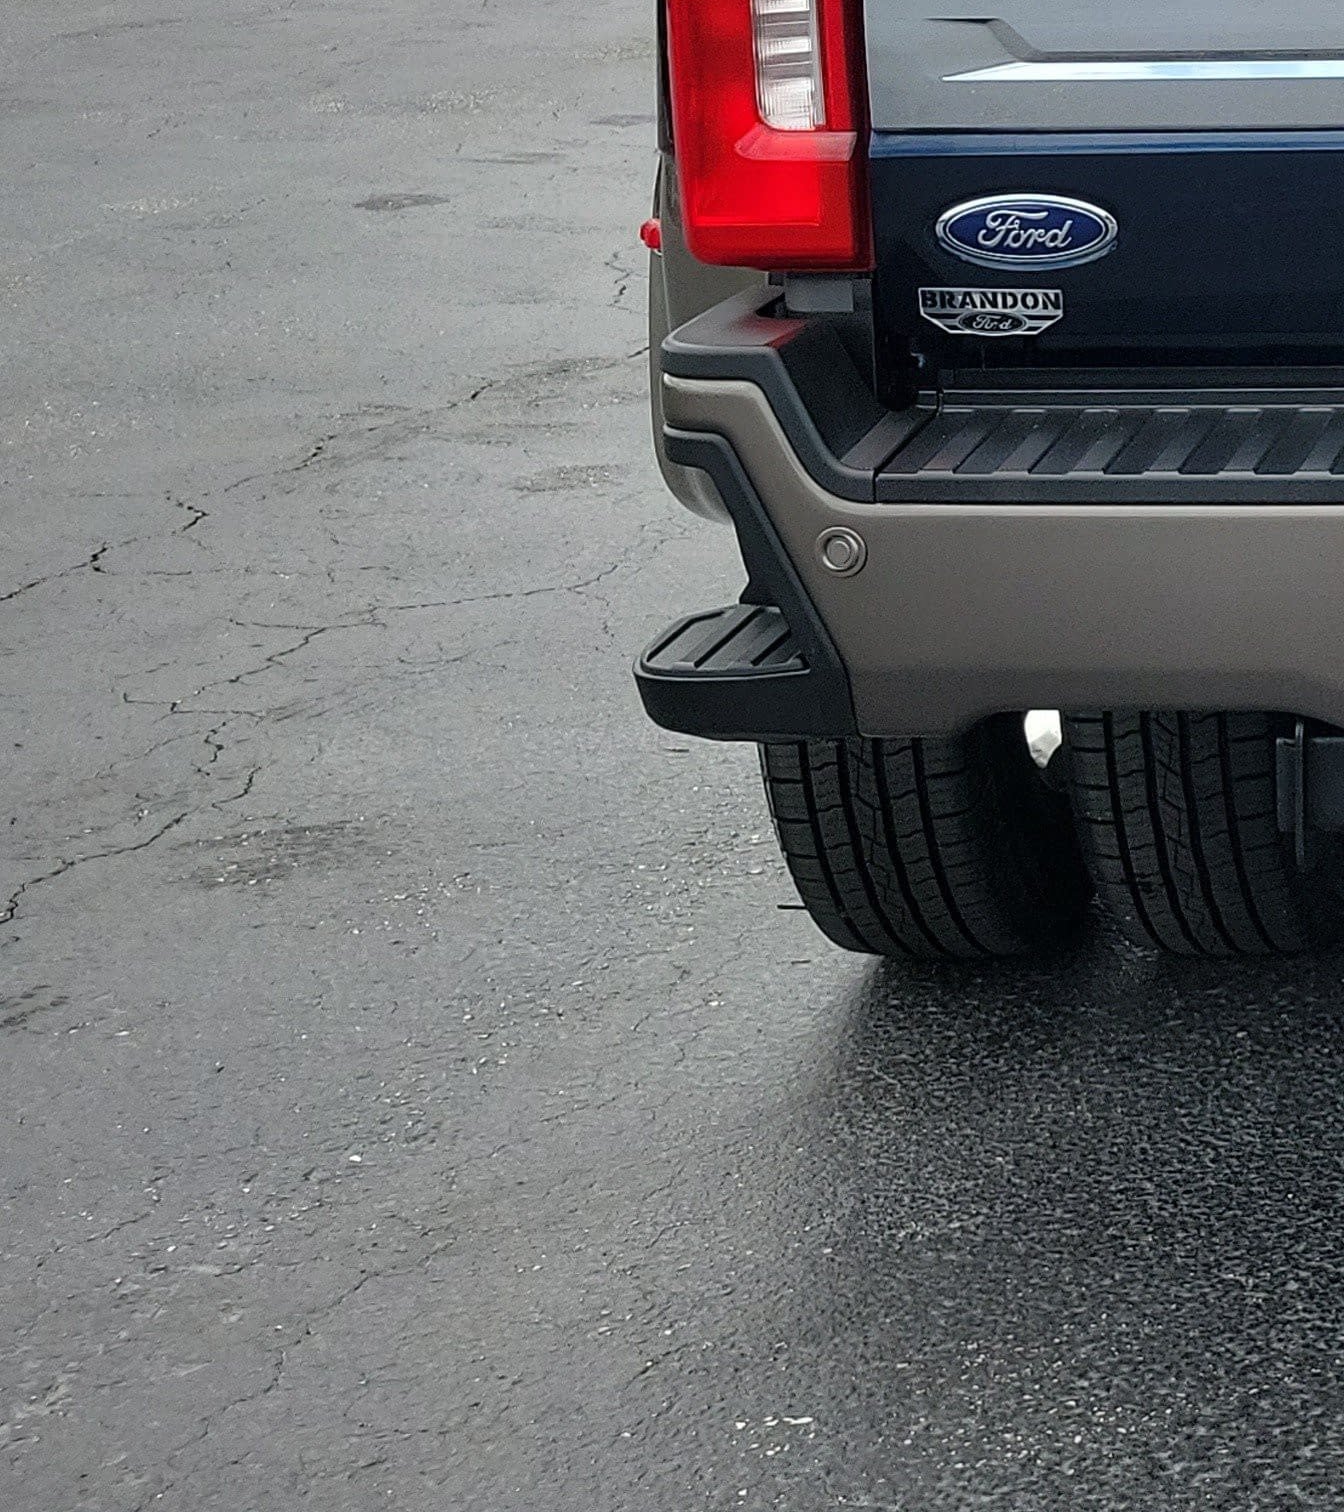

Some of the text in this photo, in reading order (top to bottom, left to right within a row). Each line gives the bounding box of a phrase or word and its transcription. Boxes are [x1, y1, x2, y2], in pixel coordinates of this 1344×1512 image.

[977, 209, 1073, 249] Ford
[921, 289, 1061, 311] BRANDON
[972, 314, 1013, 330] Ford
